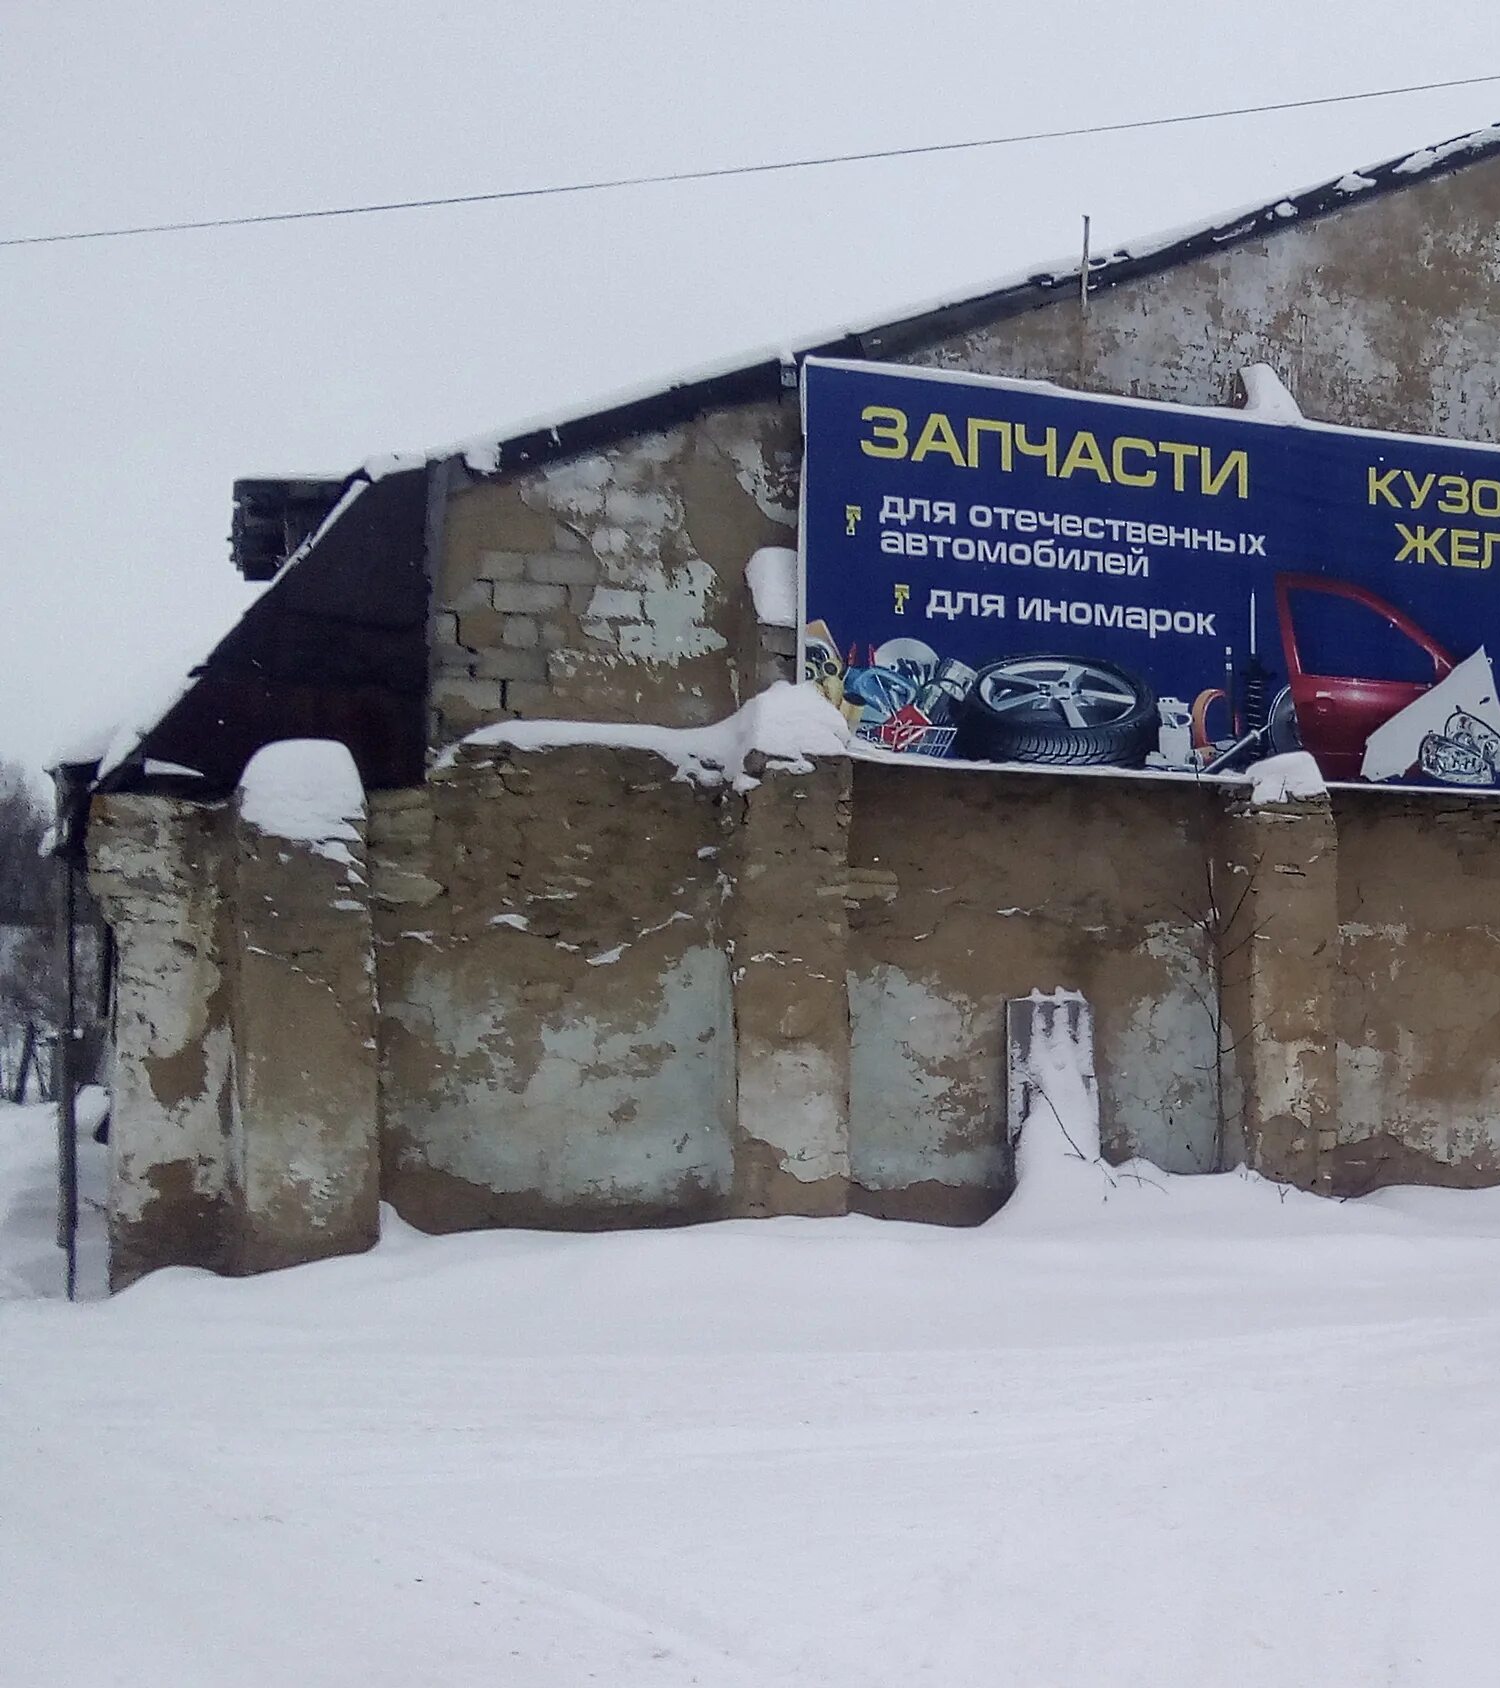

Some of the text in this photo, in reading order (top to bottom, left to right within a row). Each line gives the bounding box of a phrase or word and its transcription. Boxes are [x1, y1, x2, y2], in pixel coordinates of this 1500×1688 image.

[860, 405, 1249, 499] ЗАПЧАСТИ
[880, 495, 1267, 557] для отечественных
[880, 529, 1150, 578] автомобилей
[926, 588, 1217, 639] для иномарок
